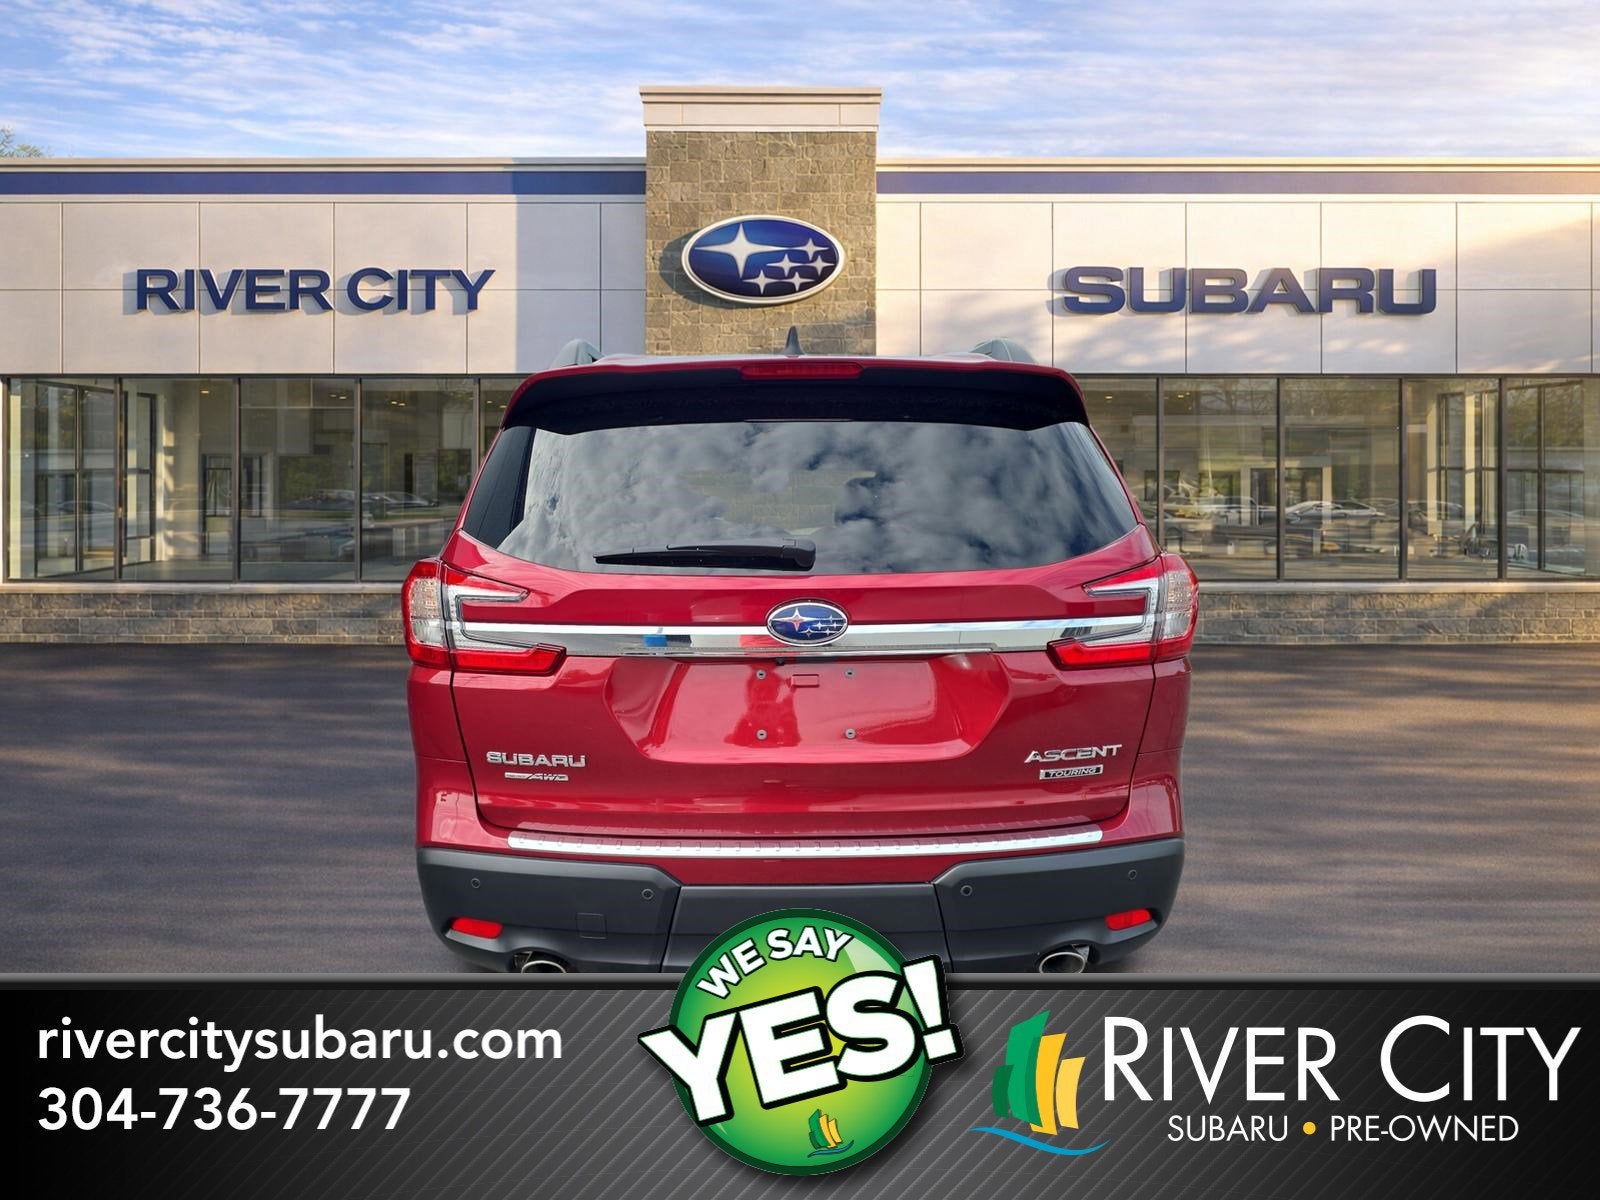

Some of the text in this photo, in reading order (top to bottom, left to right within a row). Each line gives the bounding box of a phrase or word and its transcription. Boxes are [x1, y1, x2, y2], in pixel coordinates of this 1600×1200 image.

[136, 267, 495, 311] RIVER CITY
[1063, 266, 1437, 314] SUBARU
[486, 751, 586, 767] SUBARU
[1024, 744, 1122, 763] ASCENT
[528, 773, 568, 781] AWD
[1048, 767, 1097, 778] TOURING
